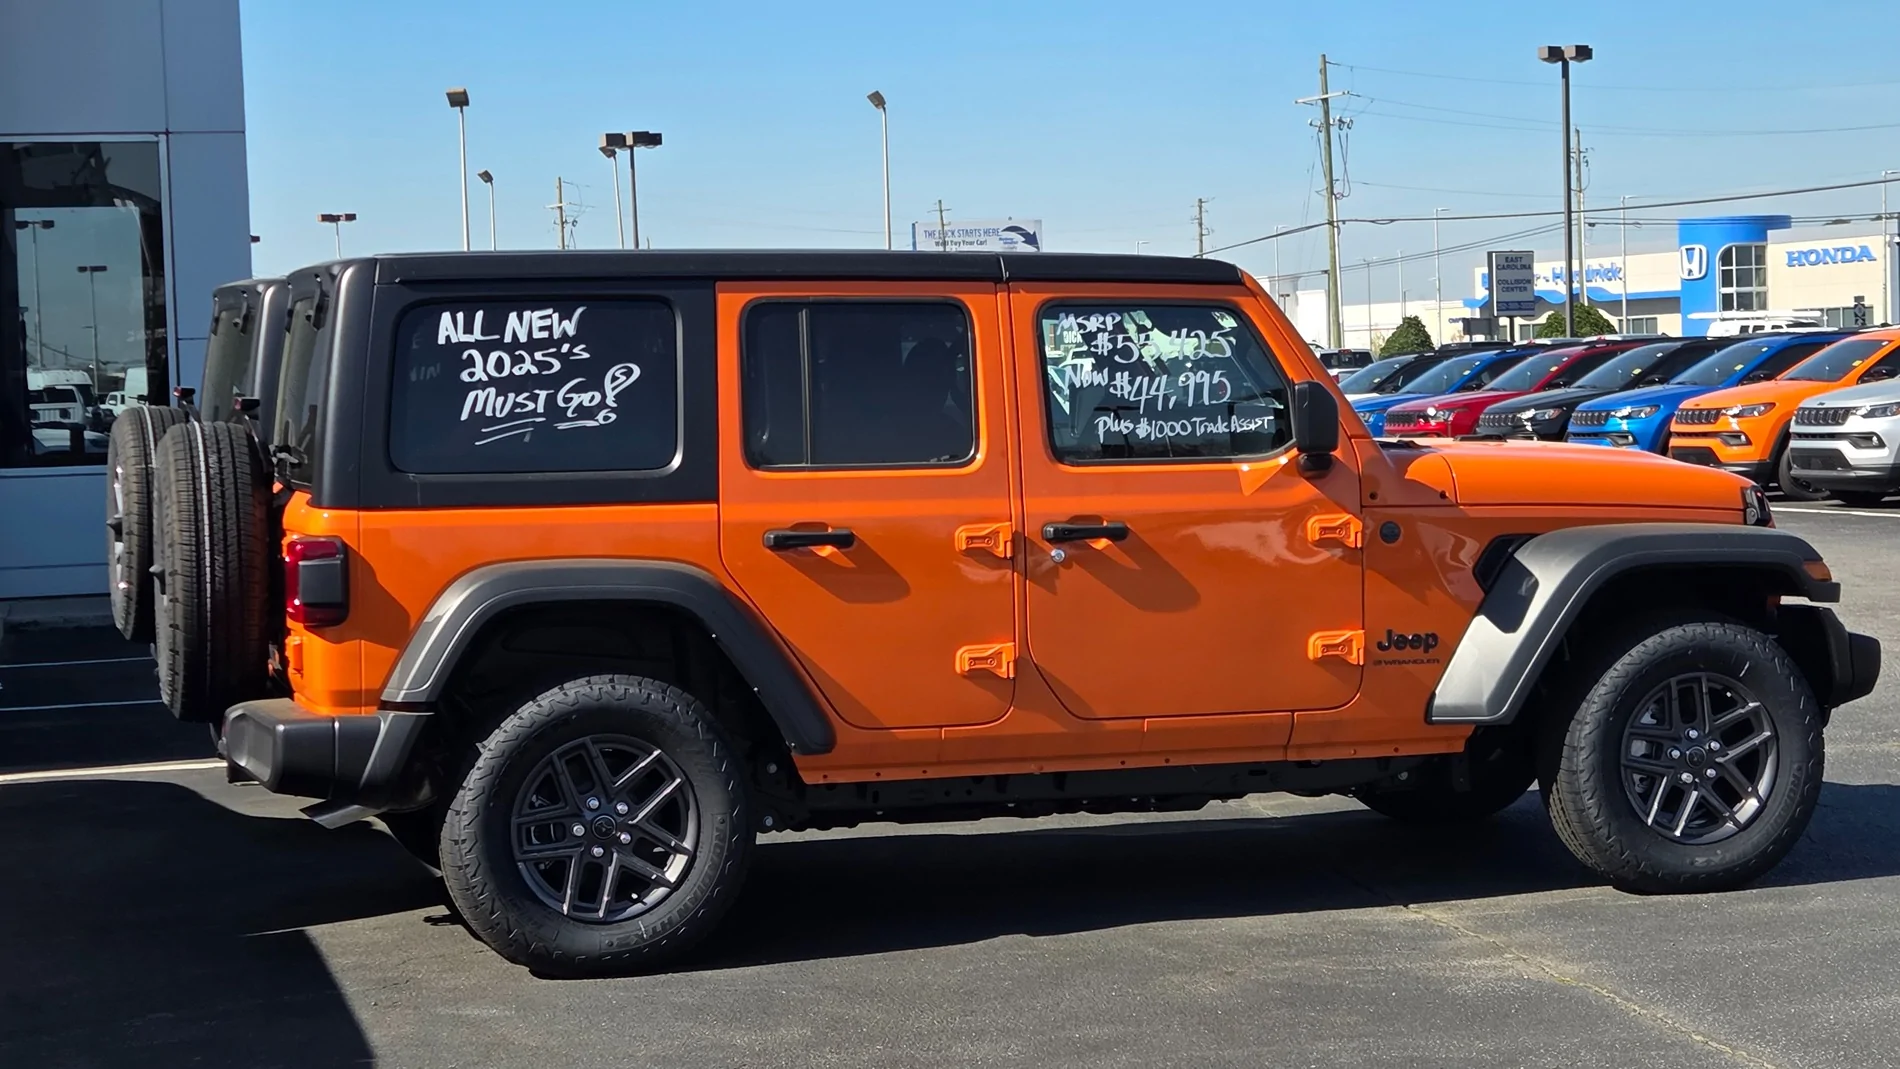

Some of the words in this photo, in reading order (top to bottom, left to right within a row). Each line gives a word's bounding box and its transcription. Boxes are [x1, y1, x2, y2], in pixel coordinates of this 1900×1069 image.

[924, 229, 936, 239] THE
[957, 228, 982, 238] STARTS
[1785, 245, 1877, 267] HONDA
[1552, 262, 1622, 283] Hndrick
[437, 310, 500, 345] ALL
[503, 306, 587, 343] NEW
[1056, 312, 1121, 335] MSRP
[460, 343, 590, 382] 2025's
[1109, 369, 1231, 414] $44,995
[1135, 417, 1192, 441] $1000
[1377, 629, 1439, 654] Jeep
